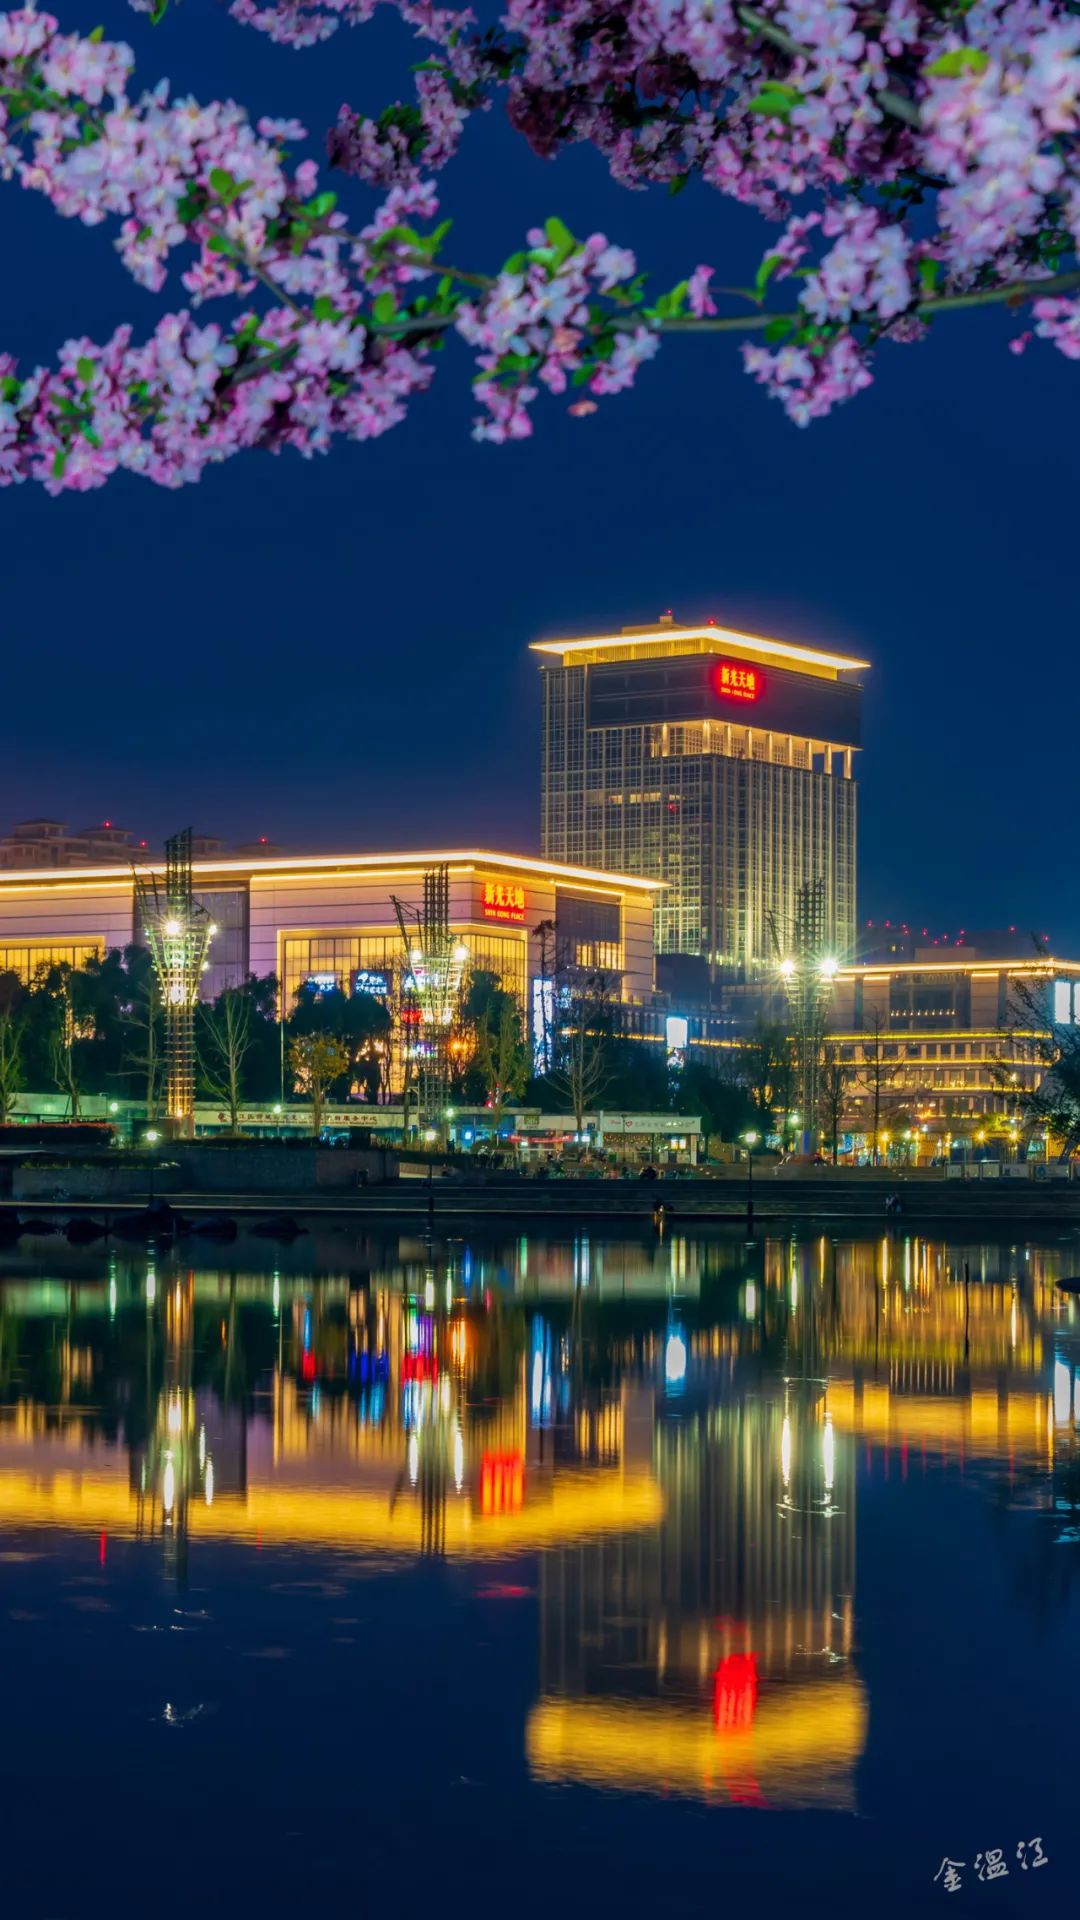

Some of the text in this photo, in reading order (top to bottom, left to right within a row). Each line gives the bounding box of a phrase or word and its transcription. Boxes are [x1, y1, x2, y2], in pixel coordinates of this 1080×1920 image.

[721, 666, 755, 690] 新光天地
[484, 882, 525, 909] 新光天地
[511, 912, 525, 920] PLACE
